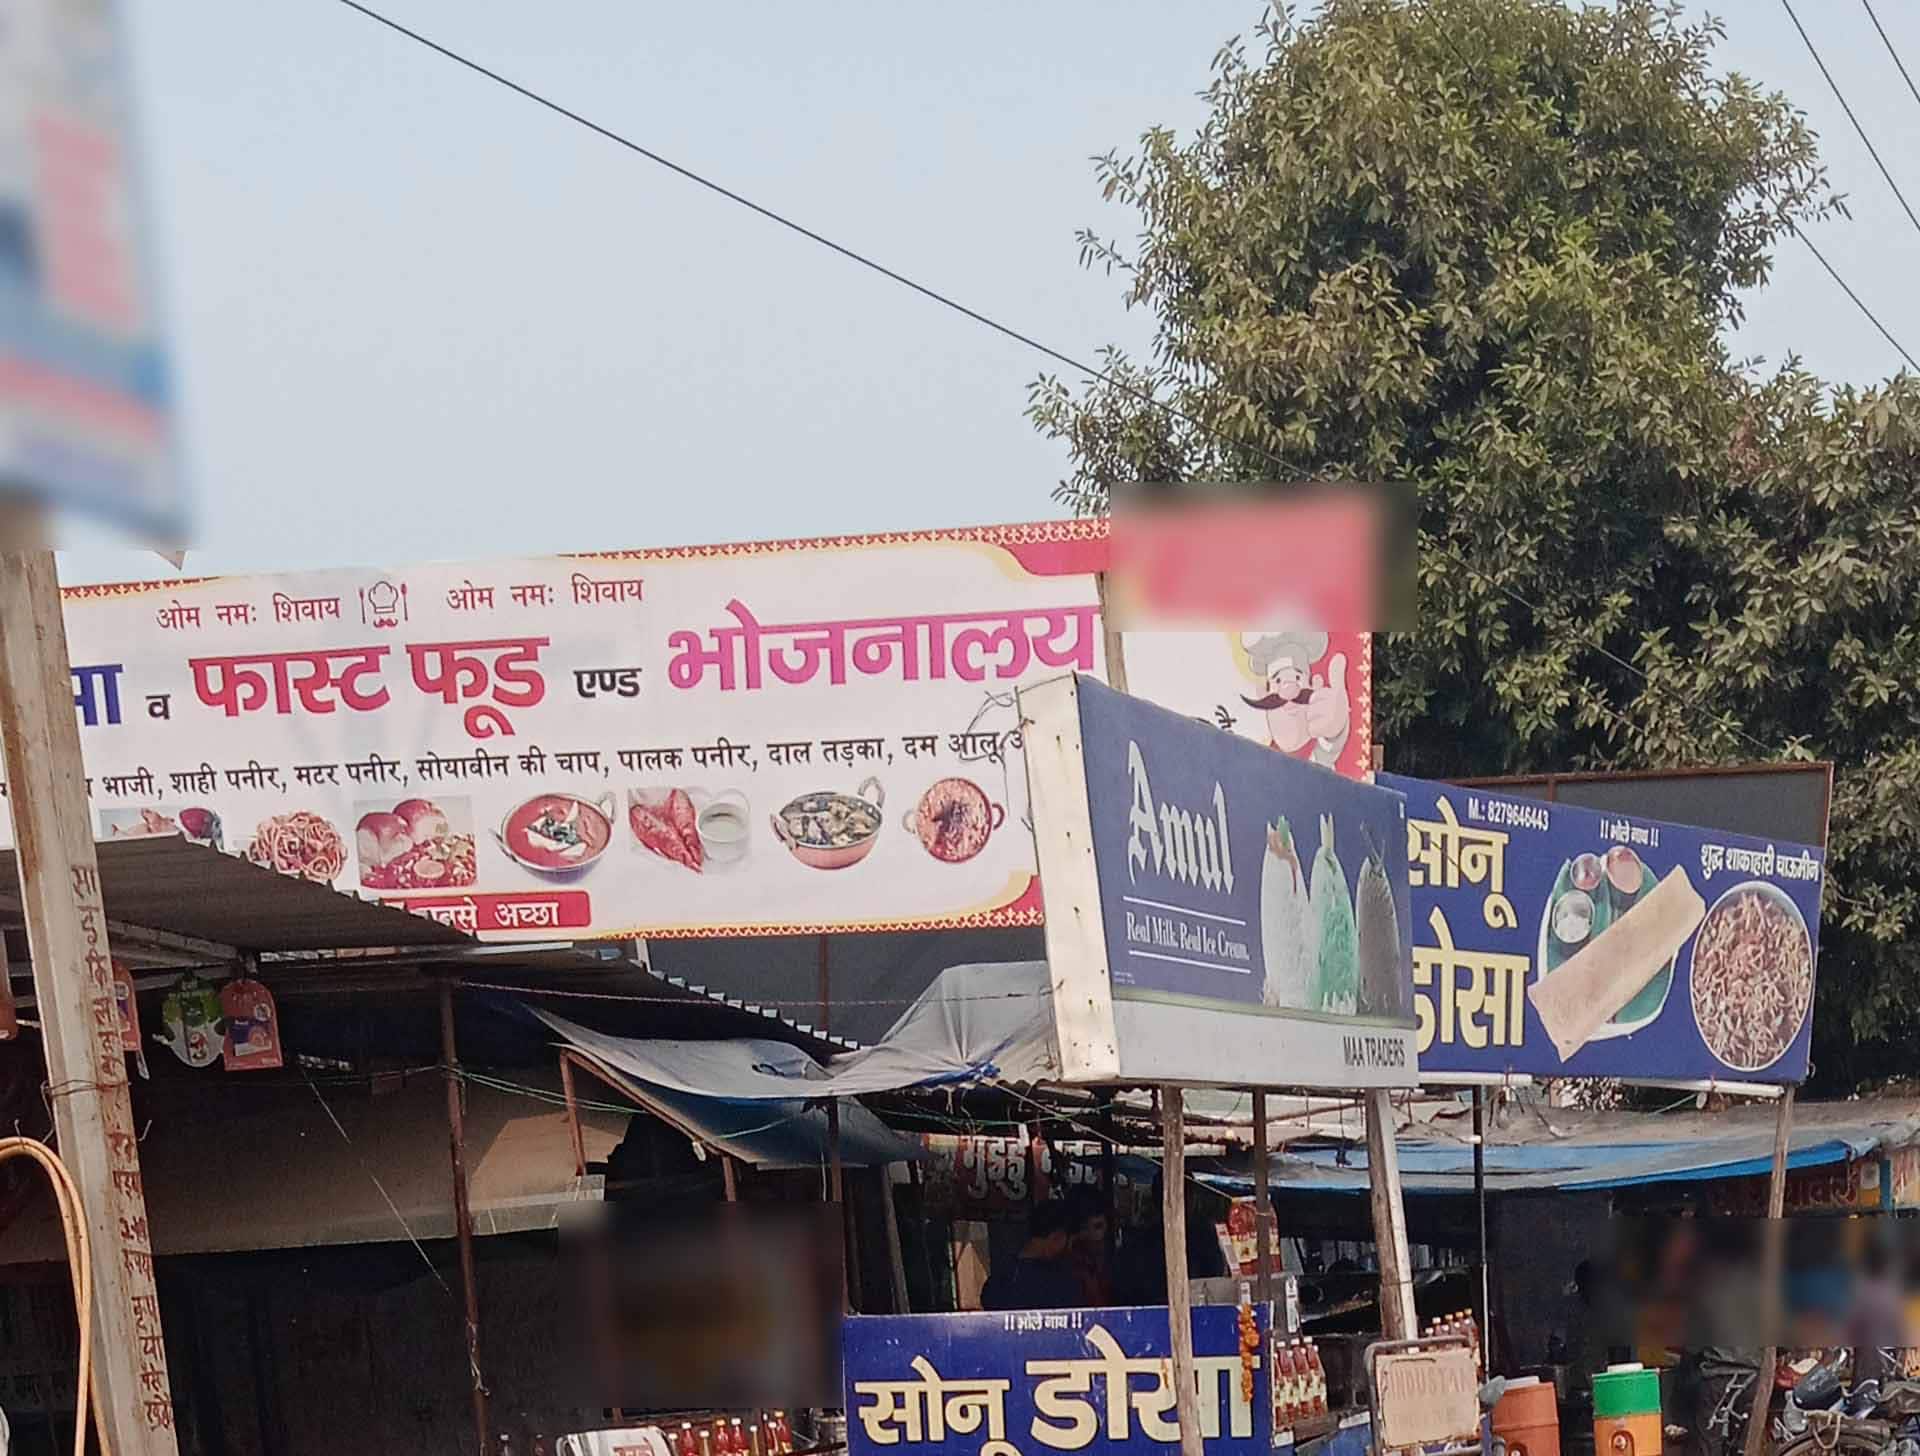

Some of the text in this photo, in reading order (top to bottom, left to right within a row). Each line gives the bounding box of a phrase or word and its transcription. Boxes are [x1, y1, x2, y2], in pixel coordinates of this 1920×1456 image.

[157, 593, 340, 629] ओम नमः शिवाय
[447, 573, 644, 610] ओम नमः शिवाय
[145, 694, 171, 720] व
[189, 645, 390, 718] फास्ट
[405, 637, 550, 739] फूड
[575, 668, 642, 698] एण्ड
[667, 598, 1102, 691] भोजनालय
[170, 762, 218, 795] शाही
[294, 763, 339, 787] मटर
[518, 745, 547, 777] की
[617, 746, 683, 773] पालक
[766, 740, 812, 766] दाल
[902, 734, 938, 759] दम
[1128, 740, 1235, 895] Amul
[1407, 796, 1518, 928] सोनू
[1726, 844, 1775, 876] शाकाहारी
[495, 901, 560, 927] अच्छा
[1126, 911, 1151, 943] Real
[1180, 922, 1202, 953] Real
[1202, 927, 1217, 955] Ice
[1343, 1036, 1405, 1067] MAA TRADERS
